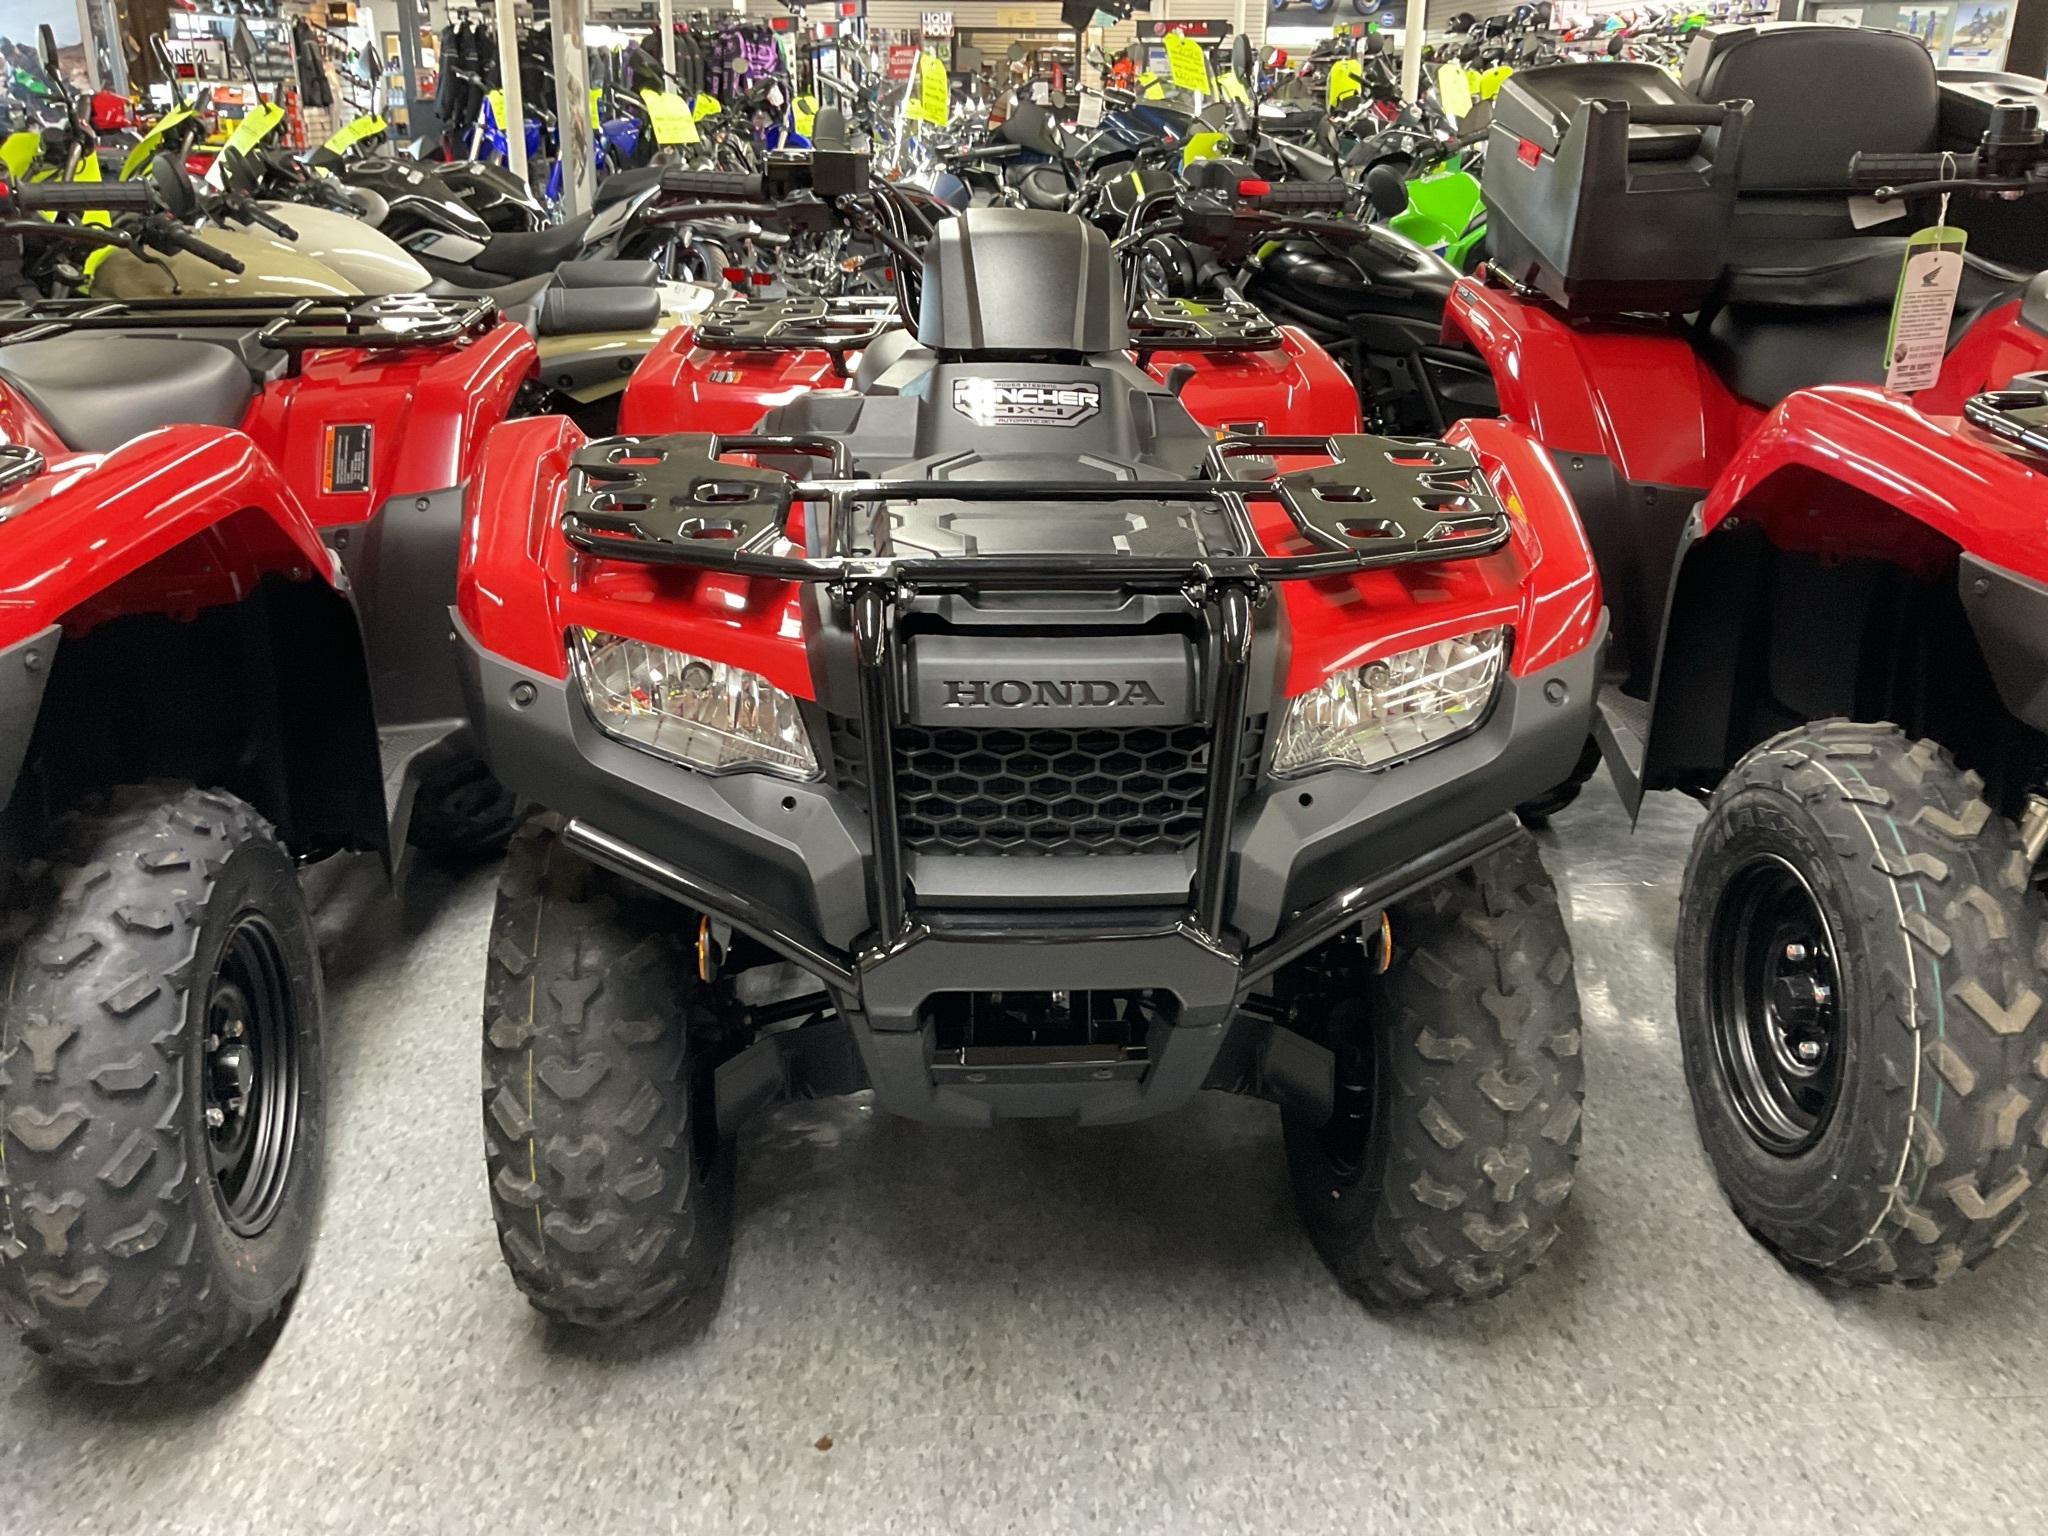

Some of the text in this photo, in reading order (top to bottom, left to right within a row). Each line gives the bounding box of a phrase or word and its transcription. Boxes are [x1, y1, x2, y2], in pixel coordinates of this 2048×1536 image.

[921, 12, 953, 24] LIQUI
[922, 24, 953, 36] MOLY
[943, 680, 1166, 708] HONDA
